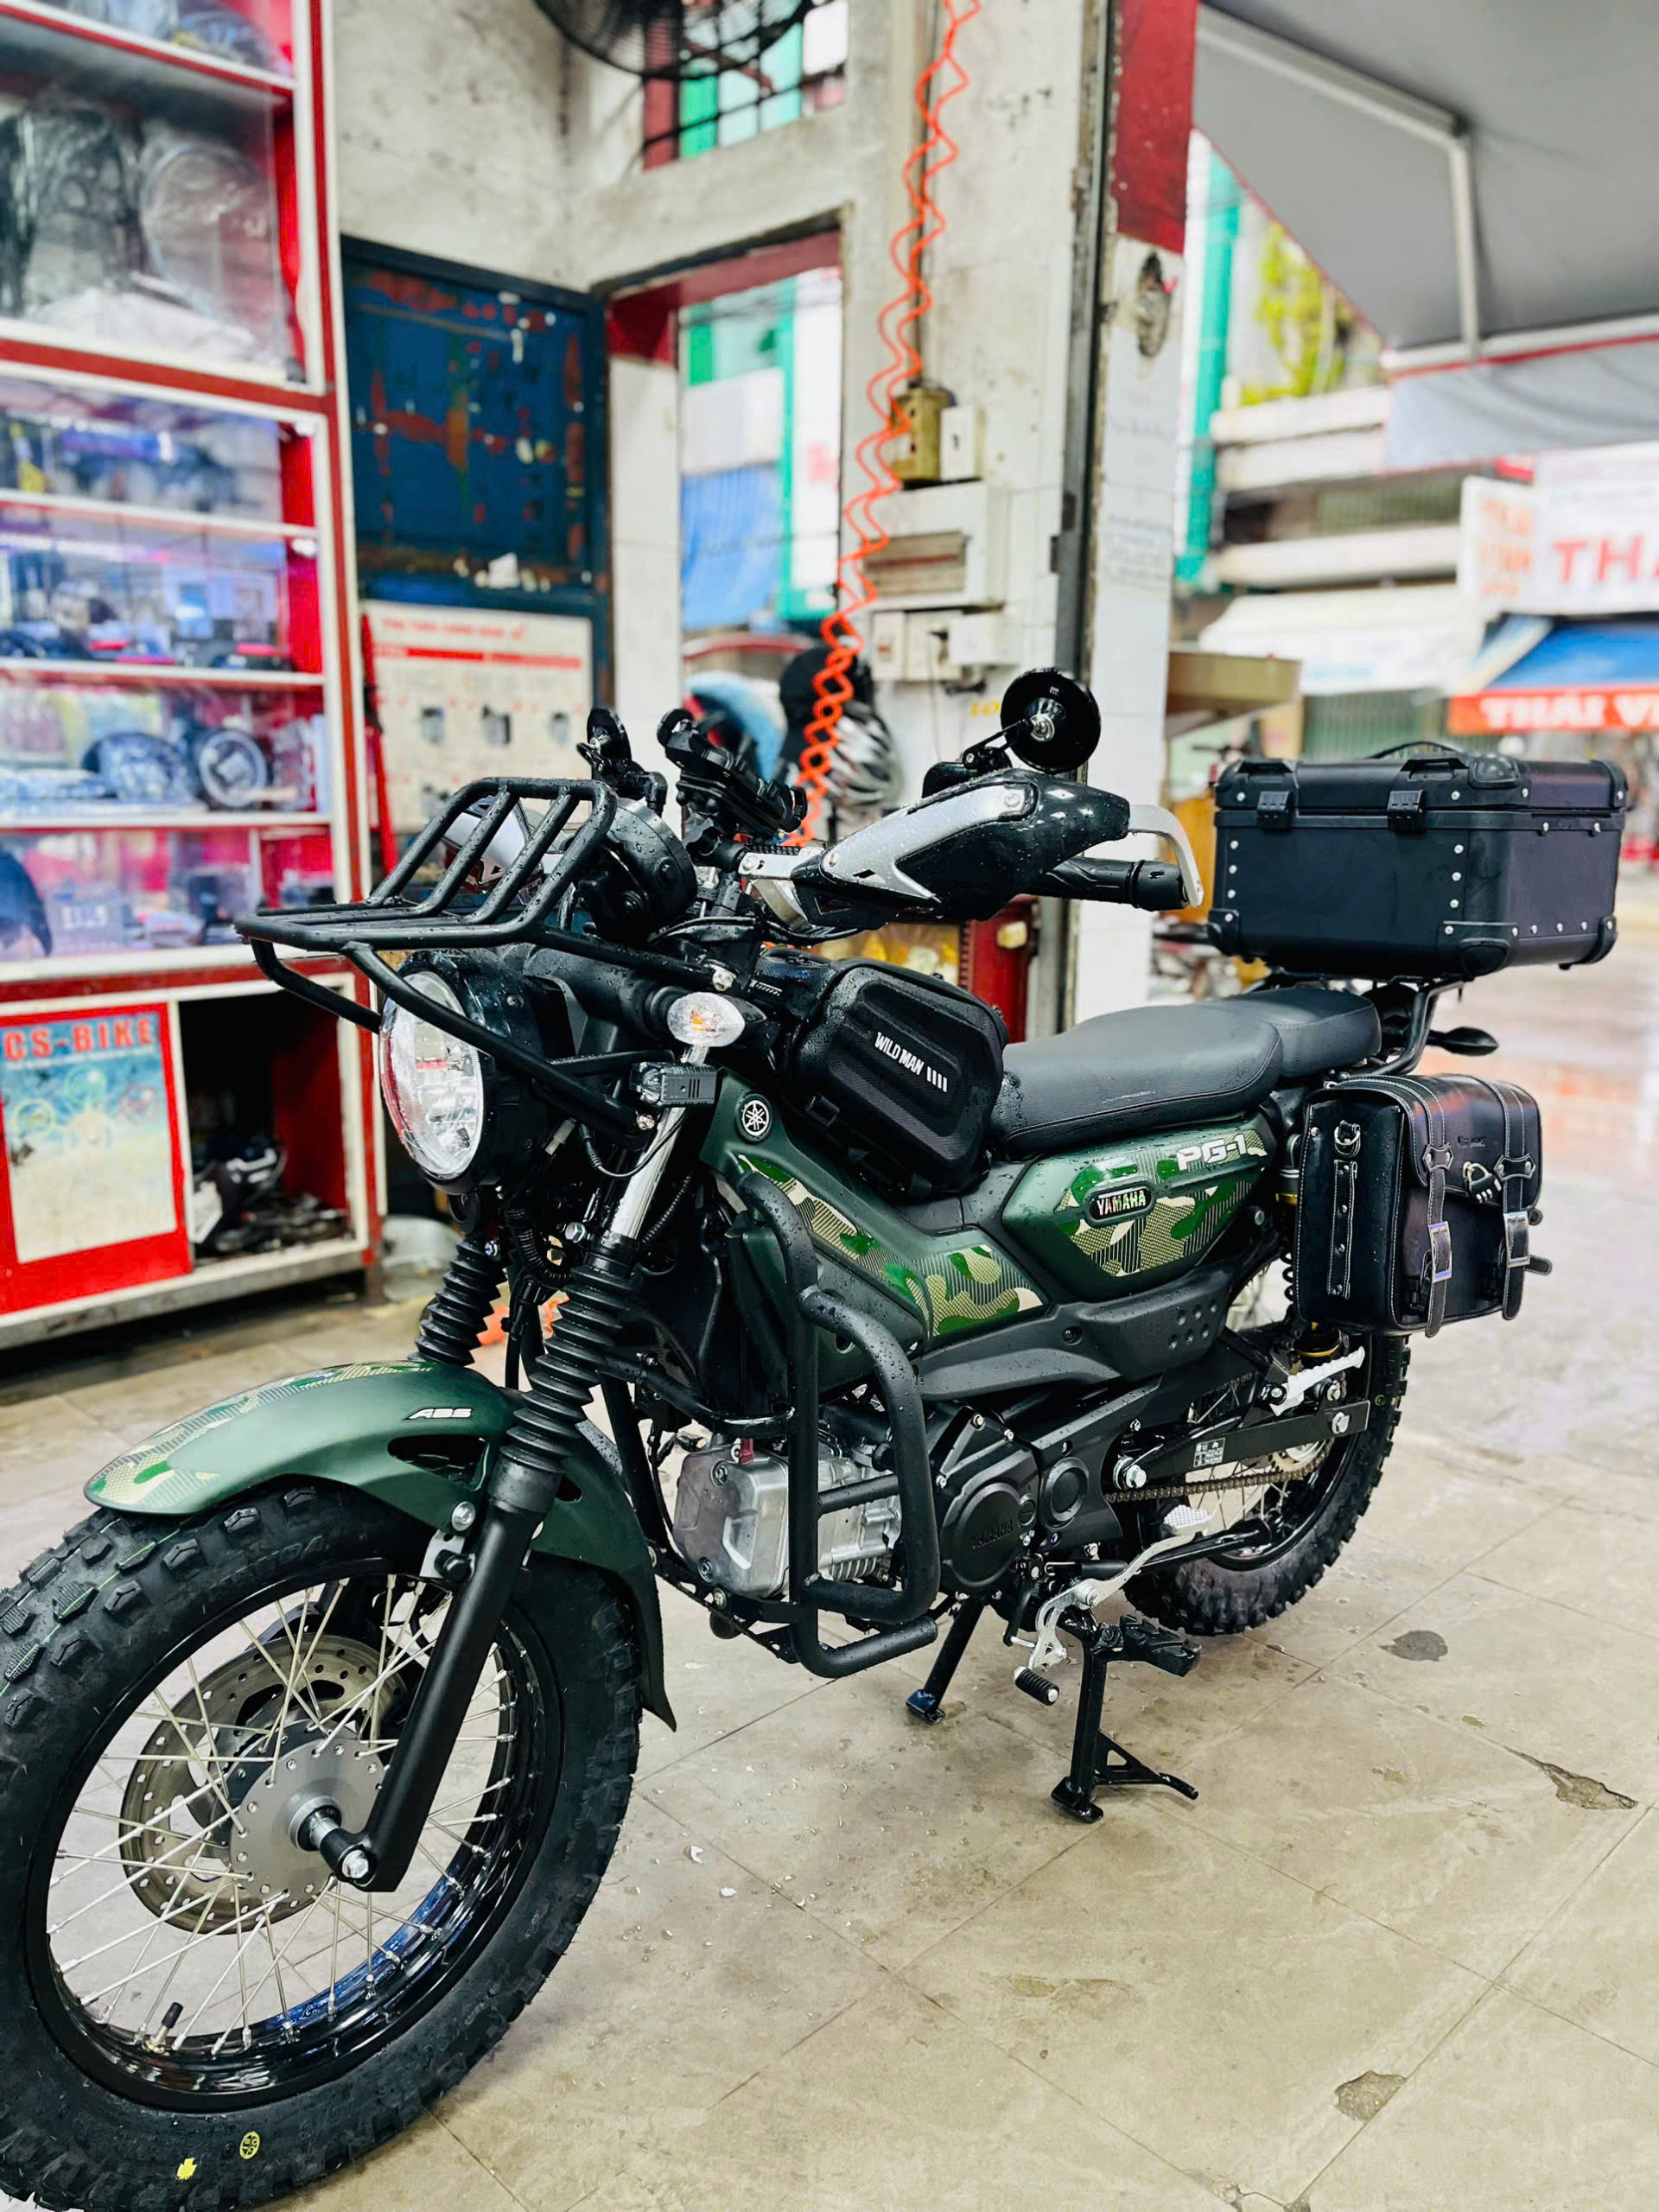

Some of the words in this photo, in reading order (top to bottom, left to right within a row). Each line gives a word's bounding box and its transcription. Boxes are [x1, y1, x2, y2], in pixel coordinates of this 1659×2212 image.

[1552, 529, 1659, 585] TH
[3, 1016, 152, 1062] CS-BIKE
[874, 1031, 901, 1060] WILD
[899, 1048, 925, 1076] MAN
[1176, 1133, 1248, 1172] PG-1
[1096, 1190, 1147, 1216] YAMAHA
[406, 1408, 473, 1420] ABS
